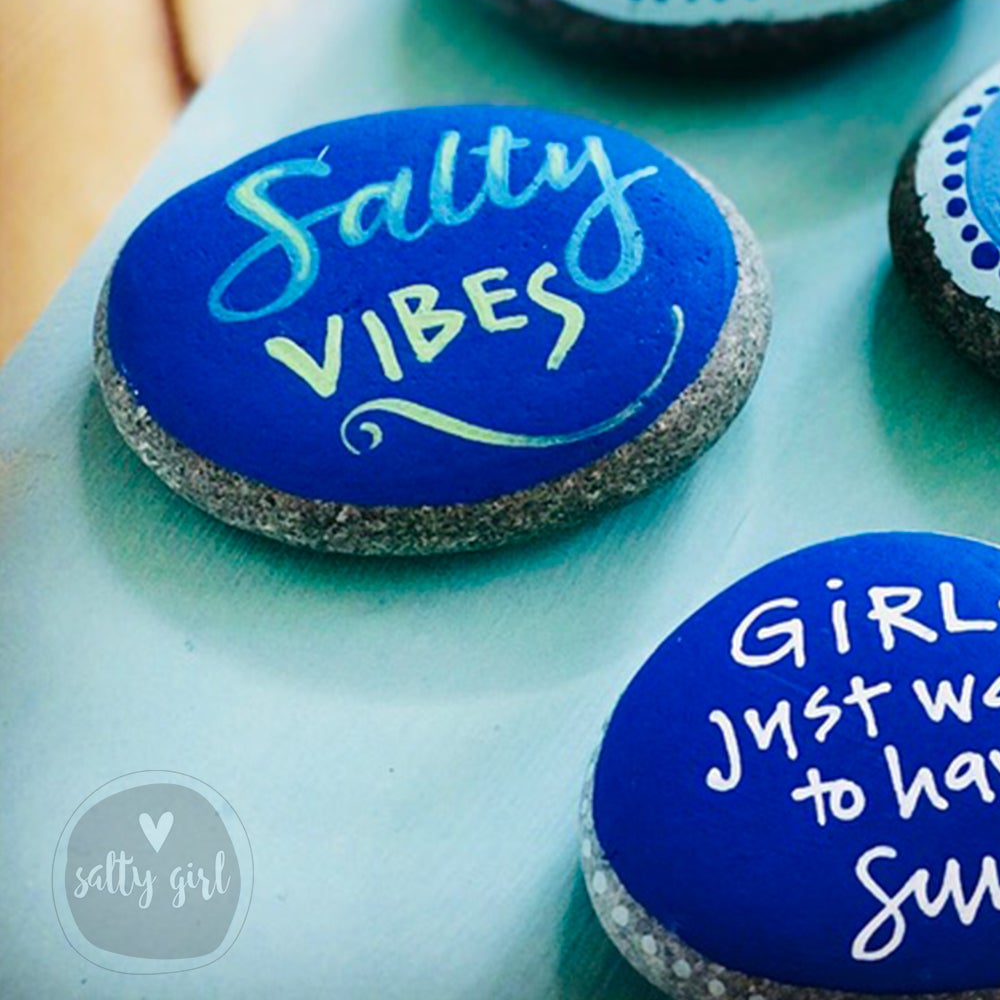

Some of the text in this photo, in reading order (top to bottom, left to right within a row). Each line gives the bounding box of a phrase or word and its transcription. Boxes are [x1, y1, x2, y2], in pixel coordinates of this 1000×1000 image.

[206, 125, 658, 322] Salty
[265, 262, 584, 397] VIBES
[791, 768, 866, 826] to
